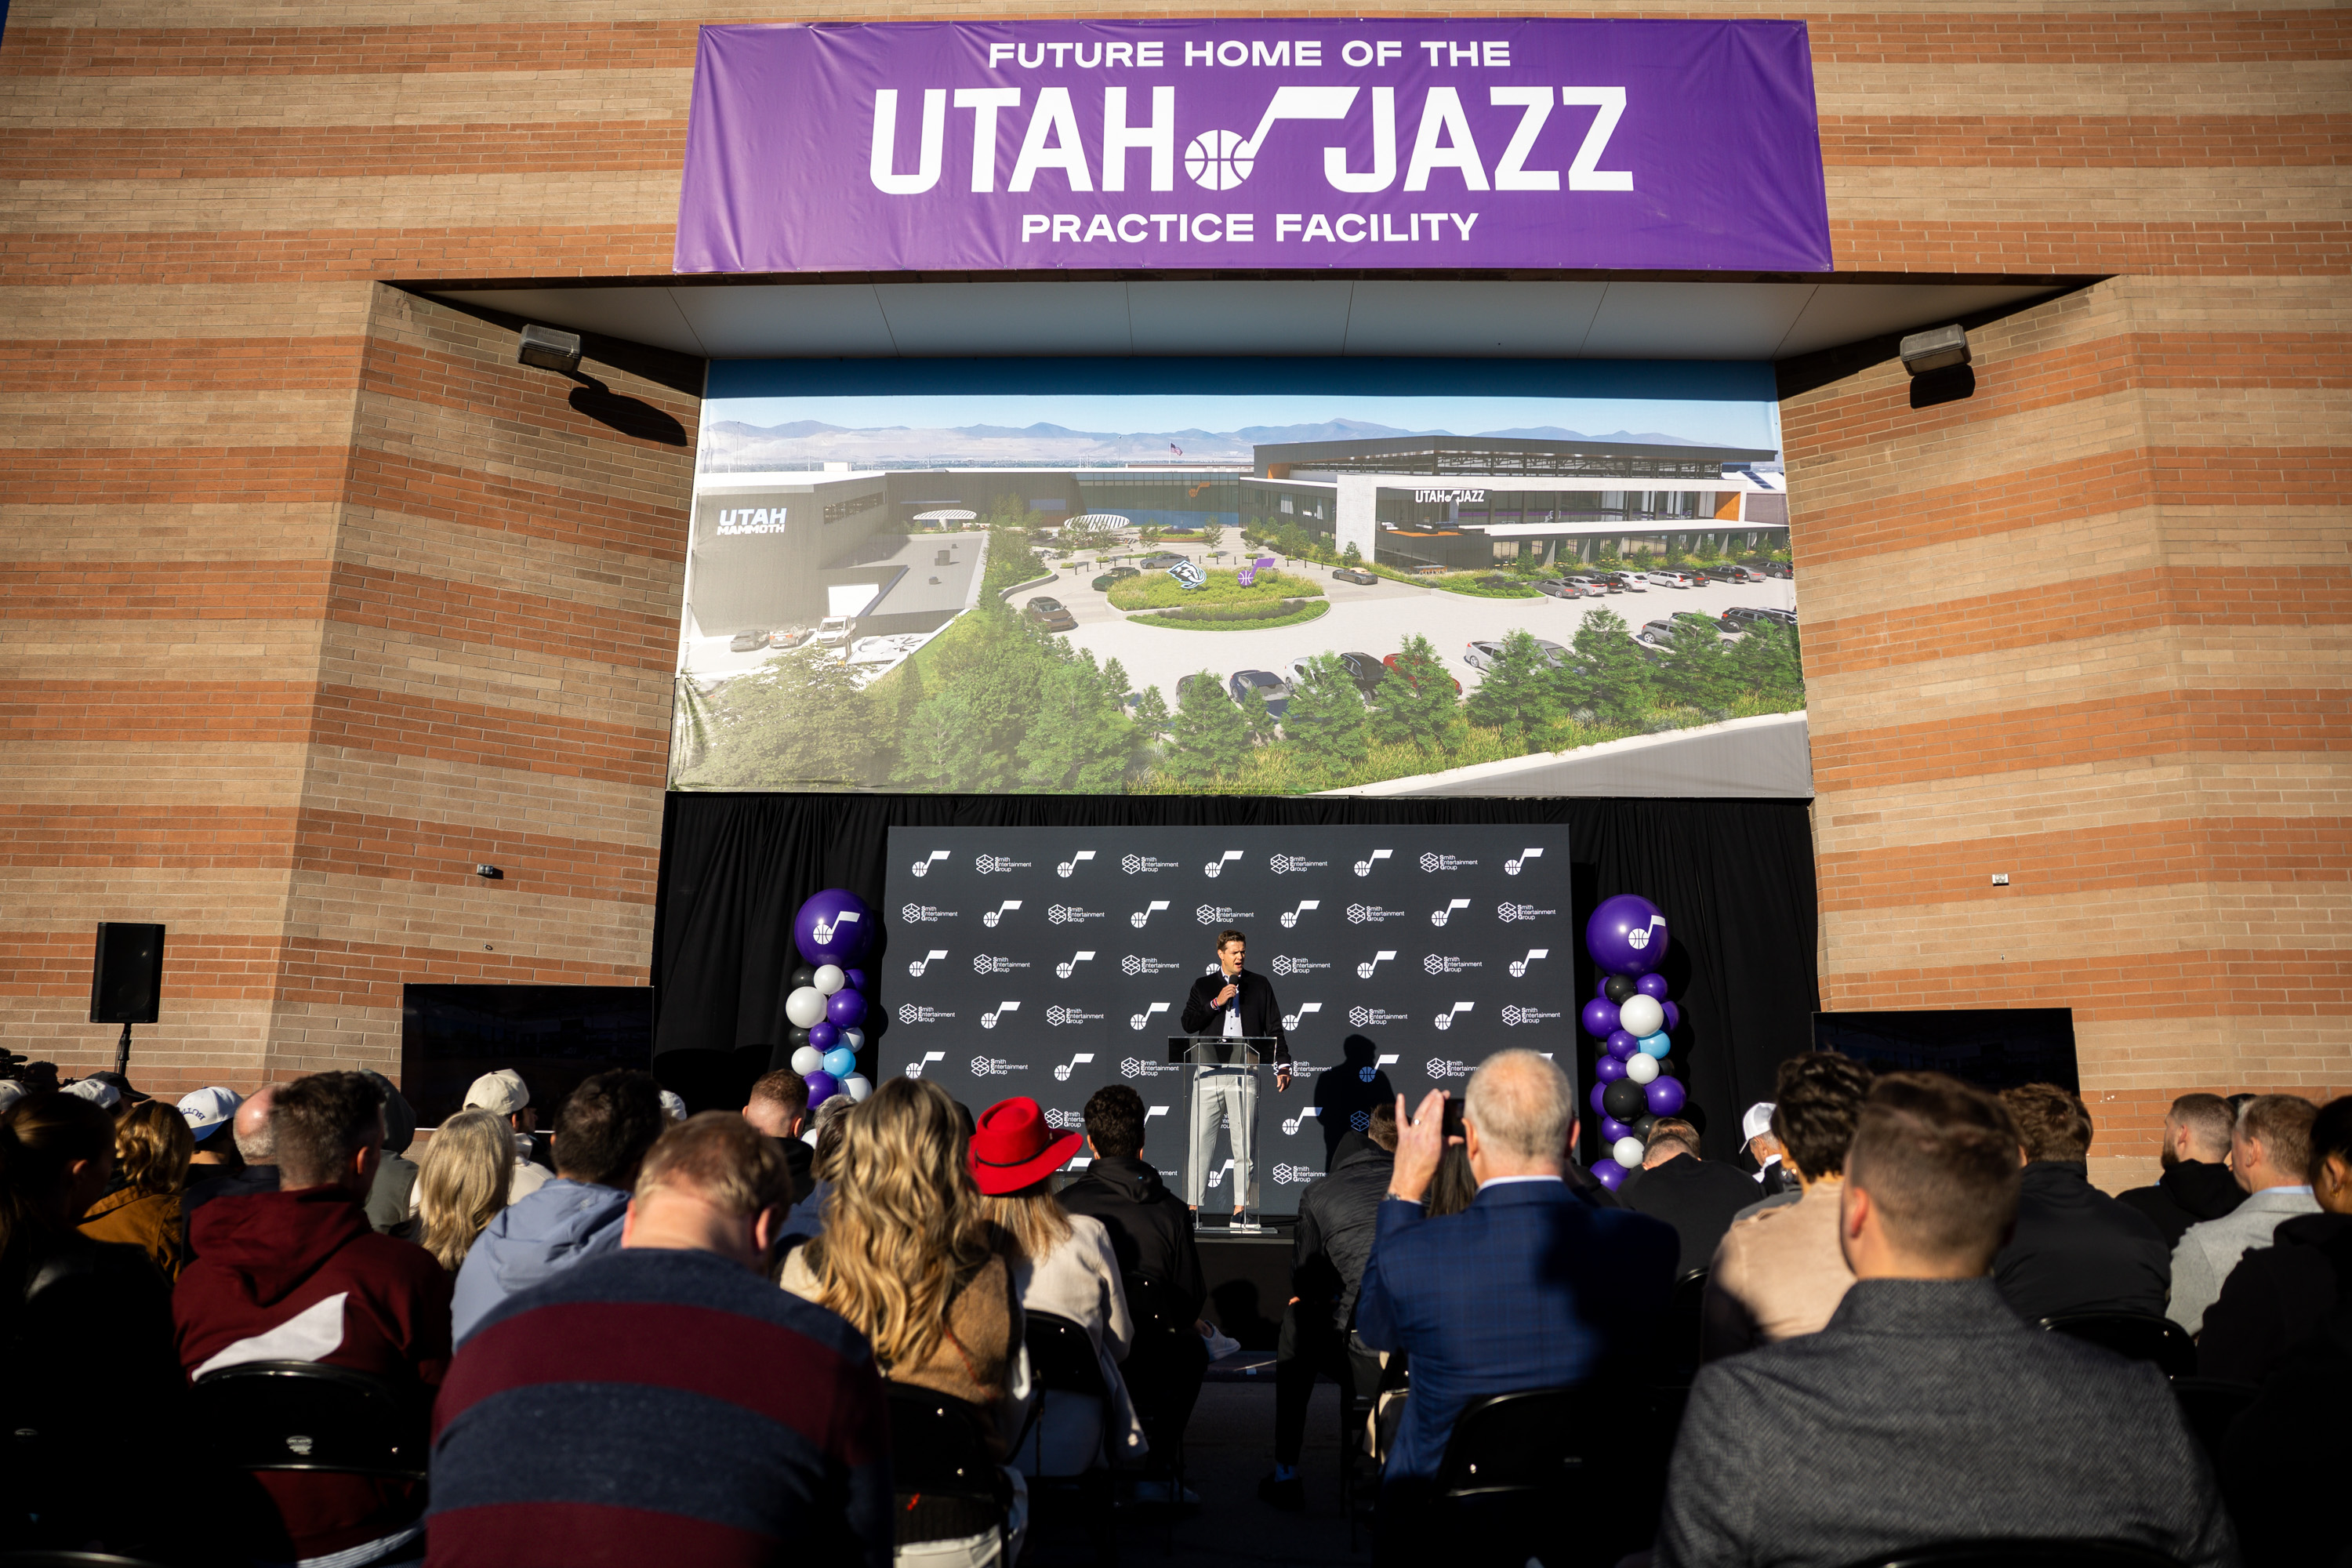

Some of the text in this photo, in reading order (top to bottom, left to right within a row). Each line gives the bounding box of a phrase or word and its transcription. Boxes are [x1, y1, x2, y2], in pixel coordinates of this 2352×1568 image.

[989, 40, 1511, 68] FUTURE HOME OF THE
[870, 86, 1634, 194] UTAH JAZZ
[1022, 212, 1479, 243] PRACTICE FACILITY
[1415, 489, 1485, 503] UTAH JAZZ
[719, 508, 787, 526] UTAH
[717, 524, 786, 535] MAMMOTH
